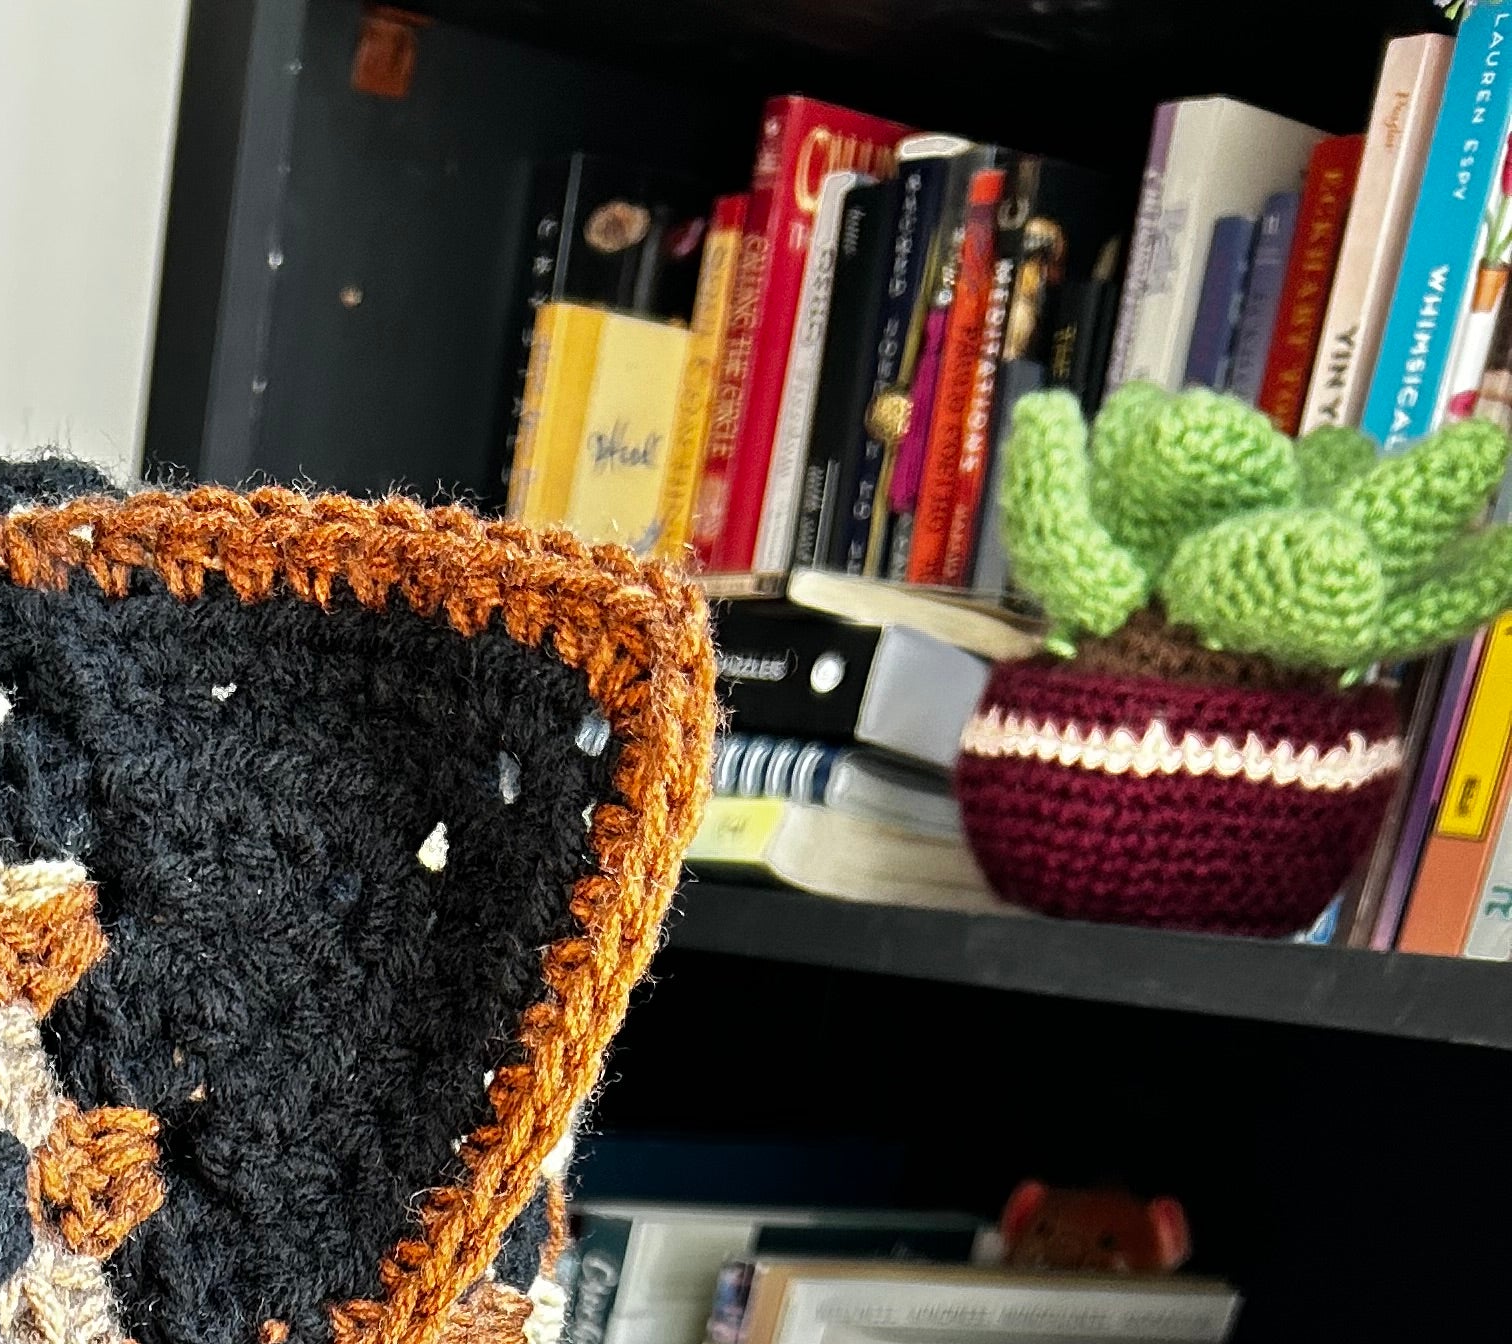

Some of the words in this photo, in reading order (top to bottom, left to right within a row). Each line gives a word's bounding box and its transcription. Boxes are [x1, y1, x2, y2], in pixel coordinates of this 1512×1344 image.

[1472, 13, 1510, 124] LAUREN
[1452, 139, 1480, 200] ESPY
[731, 233, 769, 331] CALLING
[725, 335, 754, 378] THE
[960, 258, 1014, 473] MEDITATIONS
[1326, 325, 1359, 388] YIN
[1384, 264, 1450, 451] WHIMSICAL
[707, 382, 743, 457] CIRCLE
